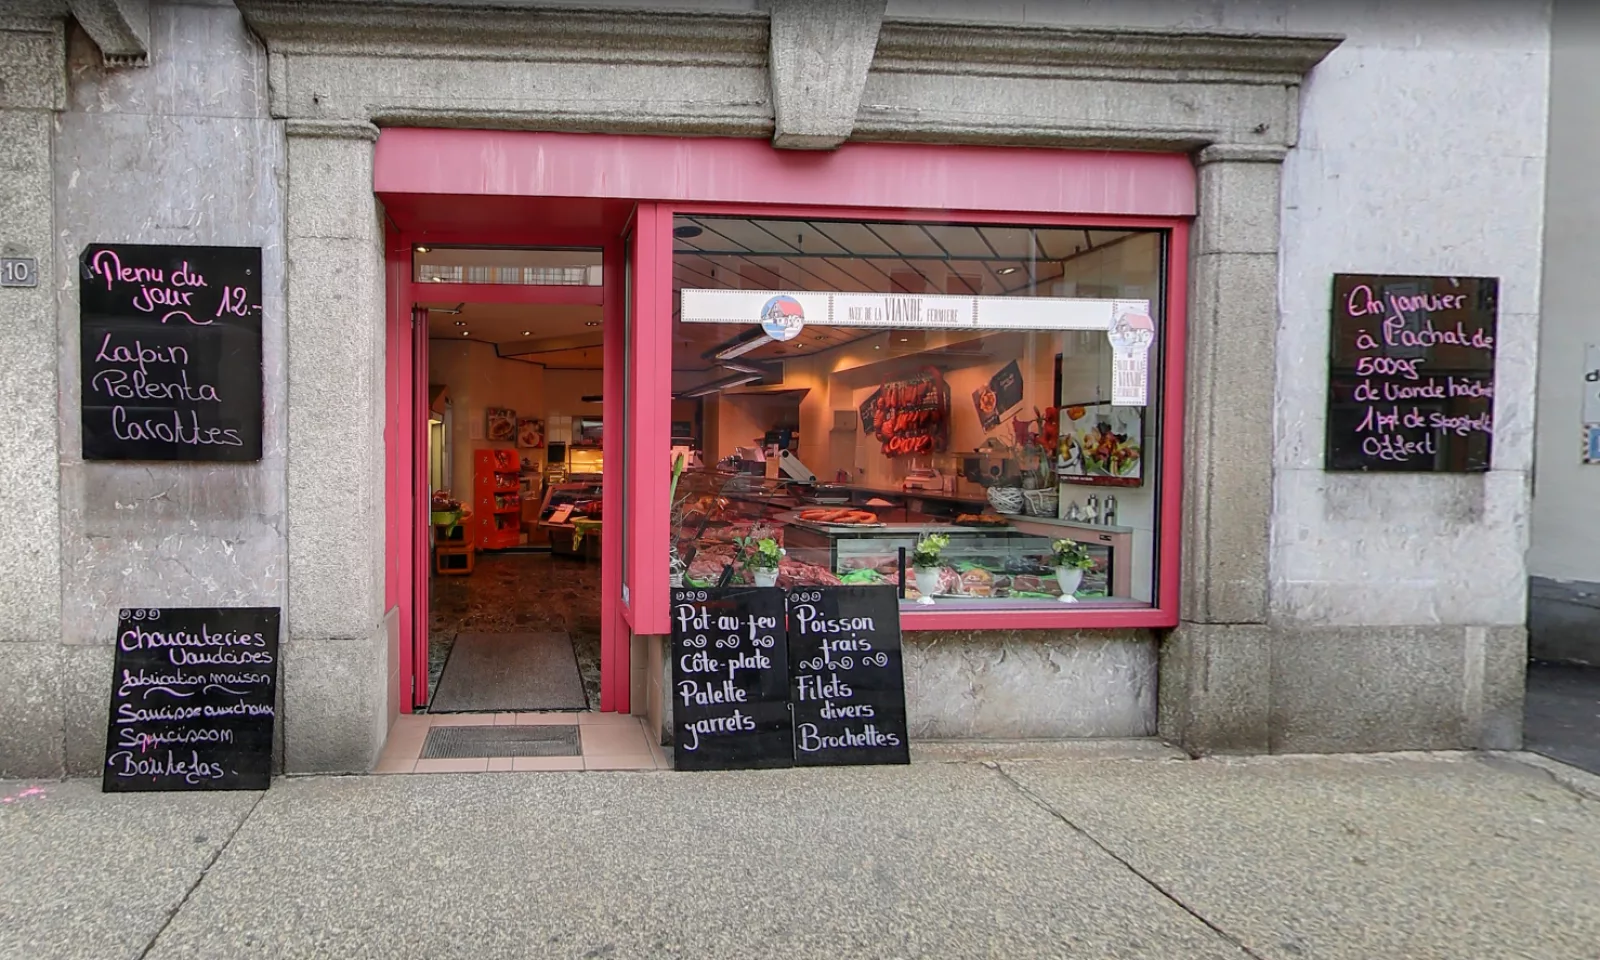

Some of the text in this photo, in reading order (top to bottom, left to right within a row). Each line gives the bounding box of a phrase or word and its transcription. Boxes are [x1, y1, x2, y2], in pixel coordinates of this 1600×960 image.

[5, 262, 28, 281] 10
[93, 250, 207, 290] Menu du
[133, 285, 194, 311] jour
[864, 307, 873, 320] DE
[874, 307, 882, 320] LA
[884, 298, 923, 321] VIANDE
[1387, 291, 1467, 328] janvier
[1472, 328, 1494, 349] de
[95, 333, 188, 375] Lapin
[1356, 357, 1425, 380] 500gr
[92, 369, 221, 402] Polenta
[1354, 378, 1381, 401] de
[112, 405, 243, 446] Carottes
[1355, 405, 1373, 432] 1
[1403, 406, 1426, 428] de
[794, 604, 875, 634] Poisson
[677, 679, 748, 706] Palette
[795, 673, 853, 700] Filets
[820, 701, 875, 720] divers
[798, 722, 901, 751] Brochettes
